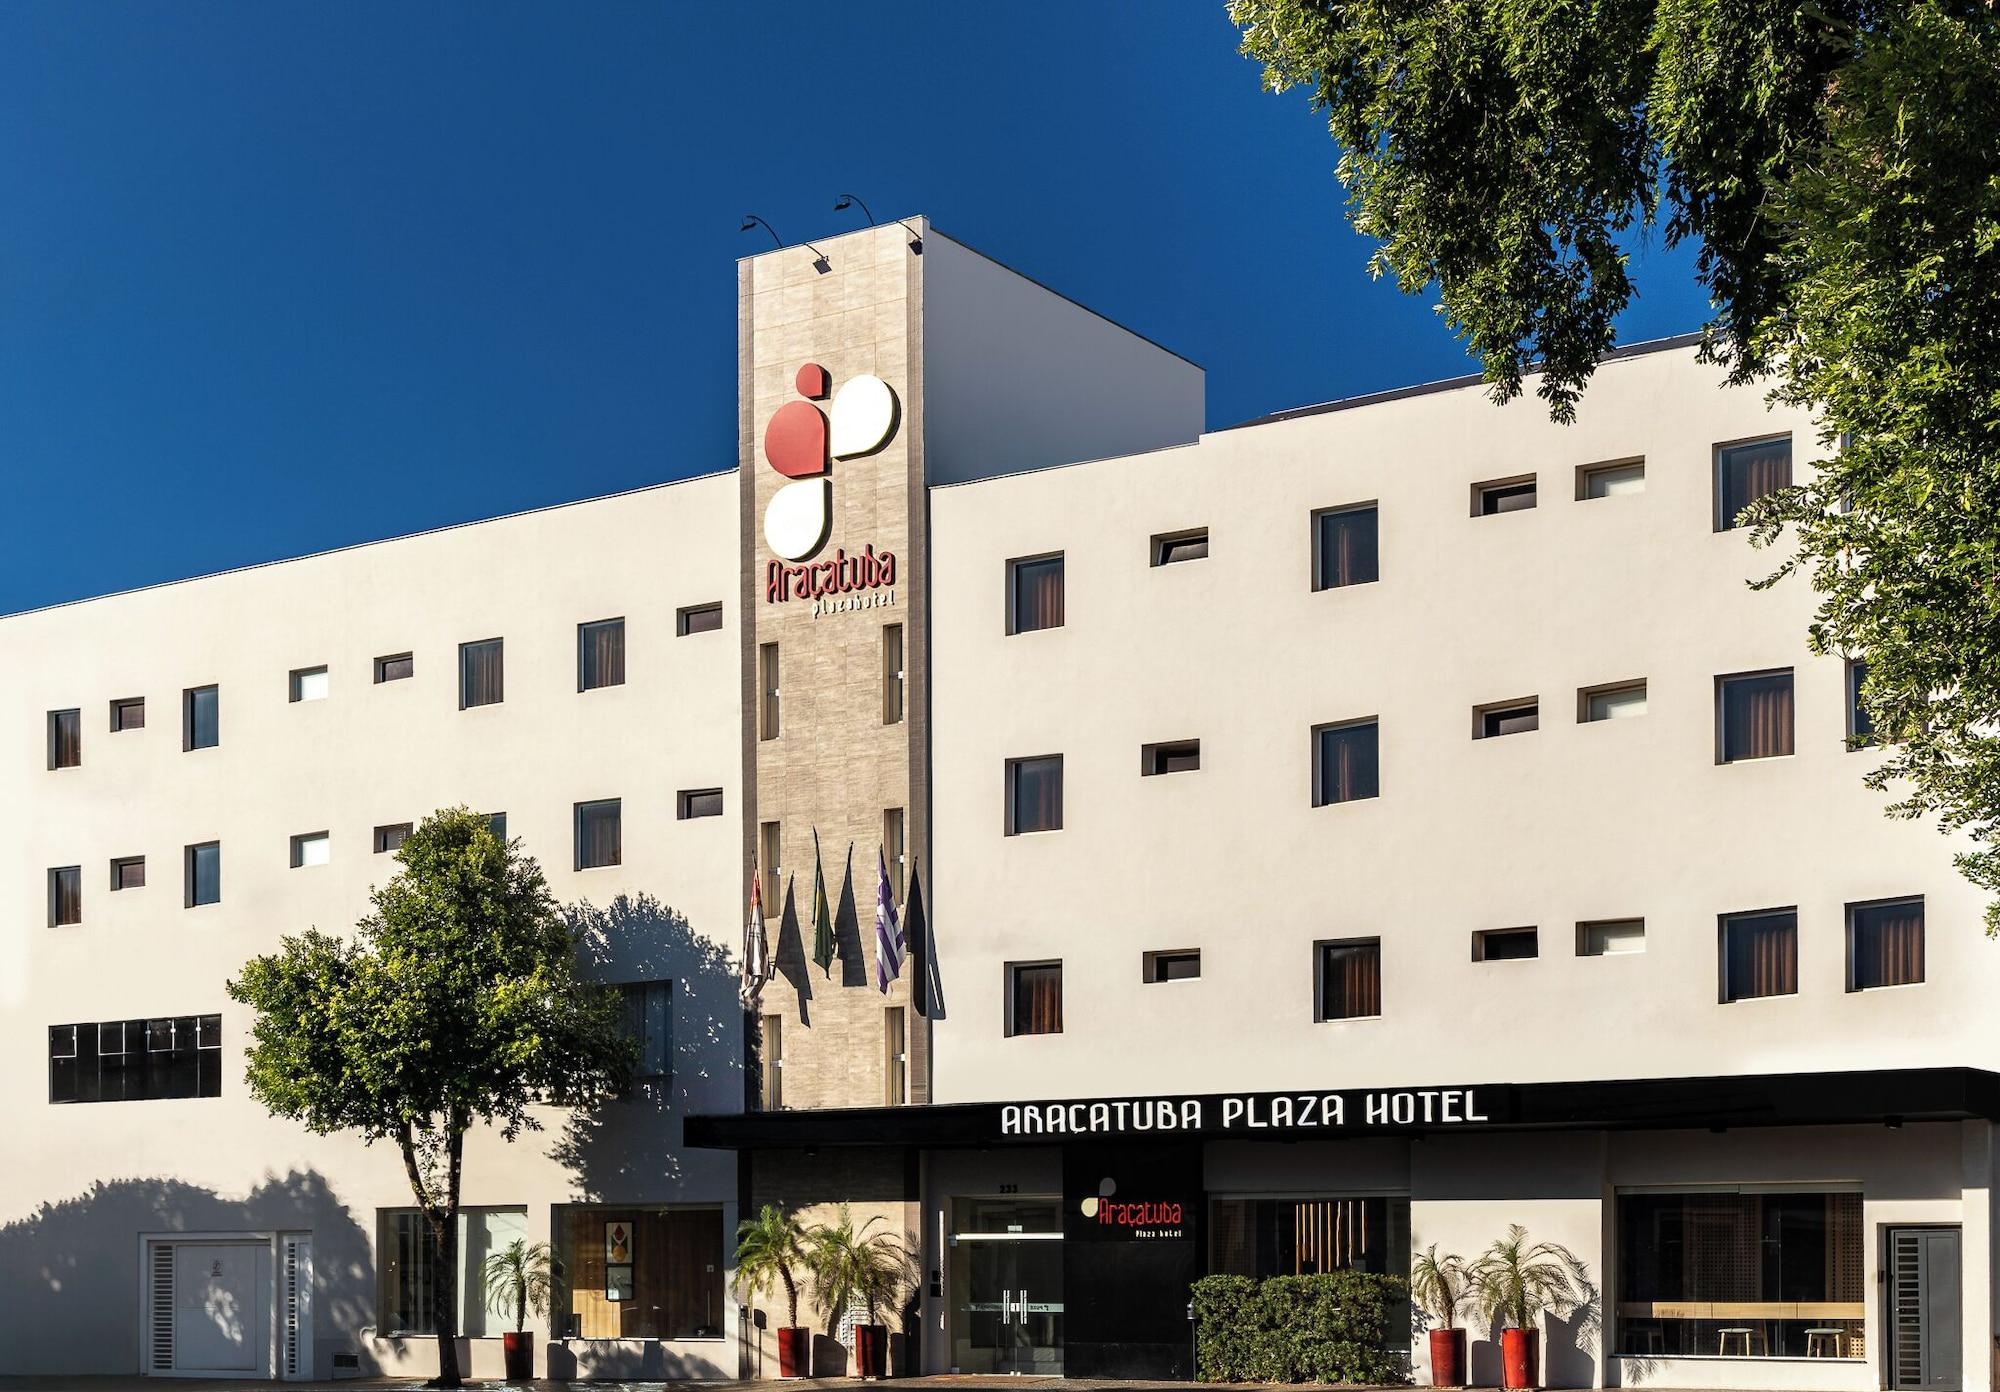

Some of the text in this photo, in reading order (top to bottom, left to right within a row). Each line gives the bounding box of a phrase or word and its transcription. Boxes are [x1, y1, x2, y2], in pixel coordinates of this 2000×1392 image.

[767, 544, 895, 603] Araçatuba
[1001, 1090, 1488, 1134] ARAÇATUBA PLAZA HOTEL
[1000, 1184, 1018, 1193] 233
[1099, 1198, 1181, 1227] Araçatuba
